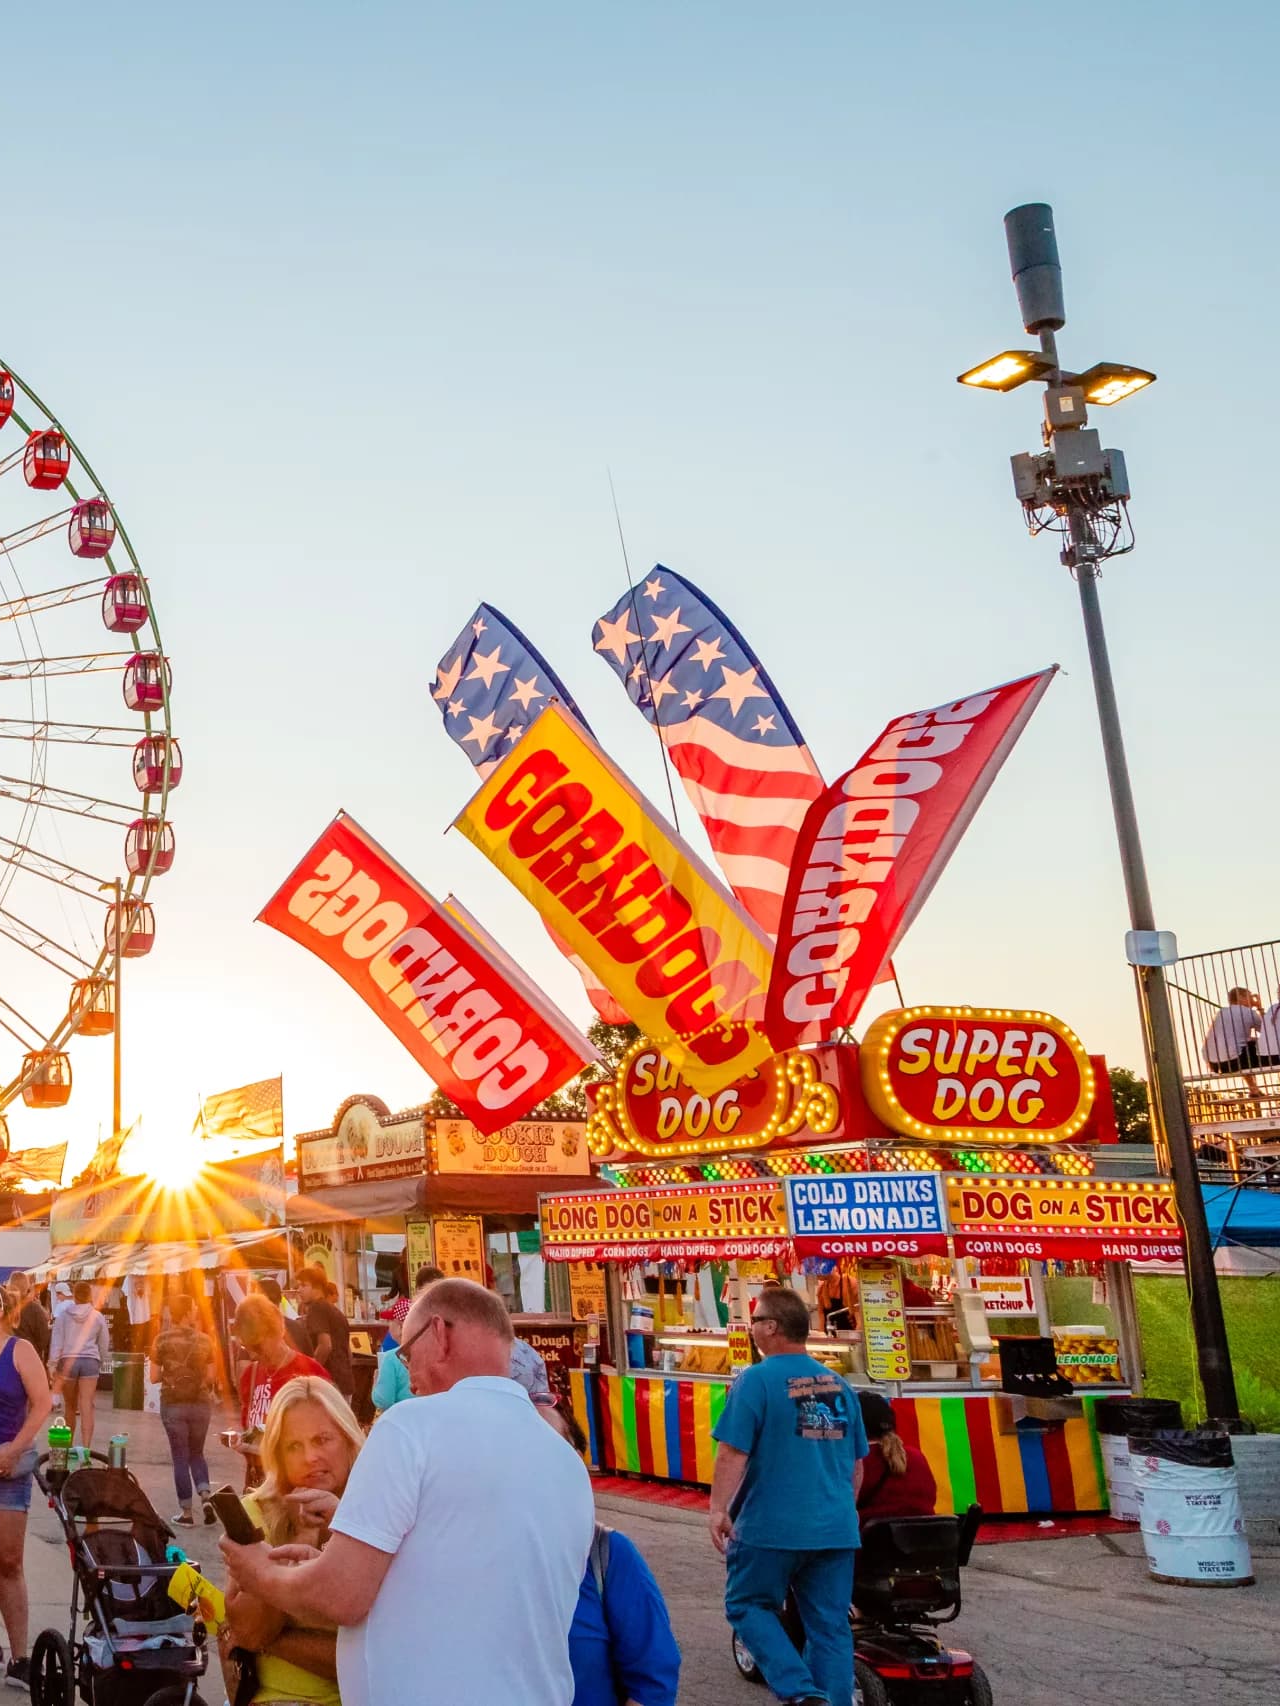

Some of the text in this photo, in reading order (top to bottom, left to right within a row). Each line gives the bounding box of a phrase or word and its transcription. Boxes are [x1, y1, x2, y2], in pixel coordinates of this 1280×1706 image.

[898, 1028, 1058, 1078] SUPER
[932, 1078, 1045, 1124] DOG
[656, 1089, 741, 1139] DOG
[483, 1145, 547, 1162] DOUGH
[794, 1180, 934, 1205] COLD DRINKS
[548, 1195, 777, 1231] LONG DOG ON A STICK
[962, 1191, 1176, 1224] DOG ON A STICK
[797, 1206, 938, 1231] LEMONADE
[569, 1247, 595, 1258] DIPPED
[604, 1247, 625, 1258] CORN
[625, 1247, 649, 1257] DOGS
[661, 1245, 687, 1257] HAND
[687, 1245, 716, 1256] DIPPED
[724, 1244, 752, 1255] CORN
[752, 1243, 780, 1255] DOGS
[821, 1240, 919, 1254] CORN DOGS
[965, 1241, 1183, 1257] CORN DOGS HAND DIPPED
[984, 1300, 1024, 1310] KETCHUP
[532, 1335, 570, 1348] Dough
[1056, 1354, 1119, 1365] LEMONADE
